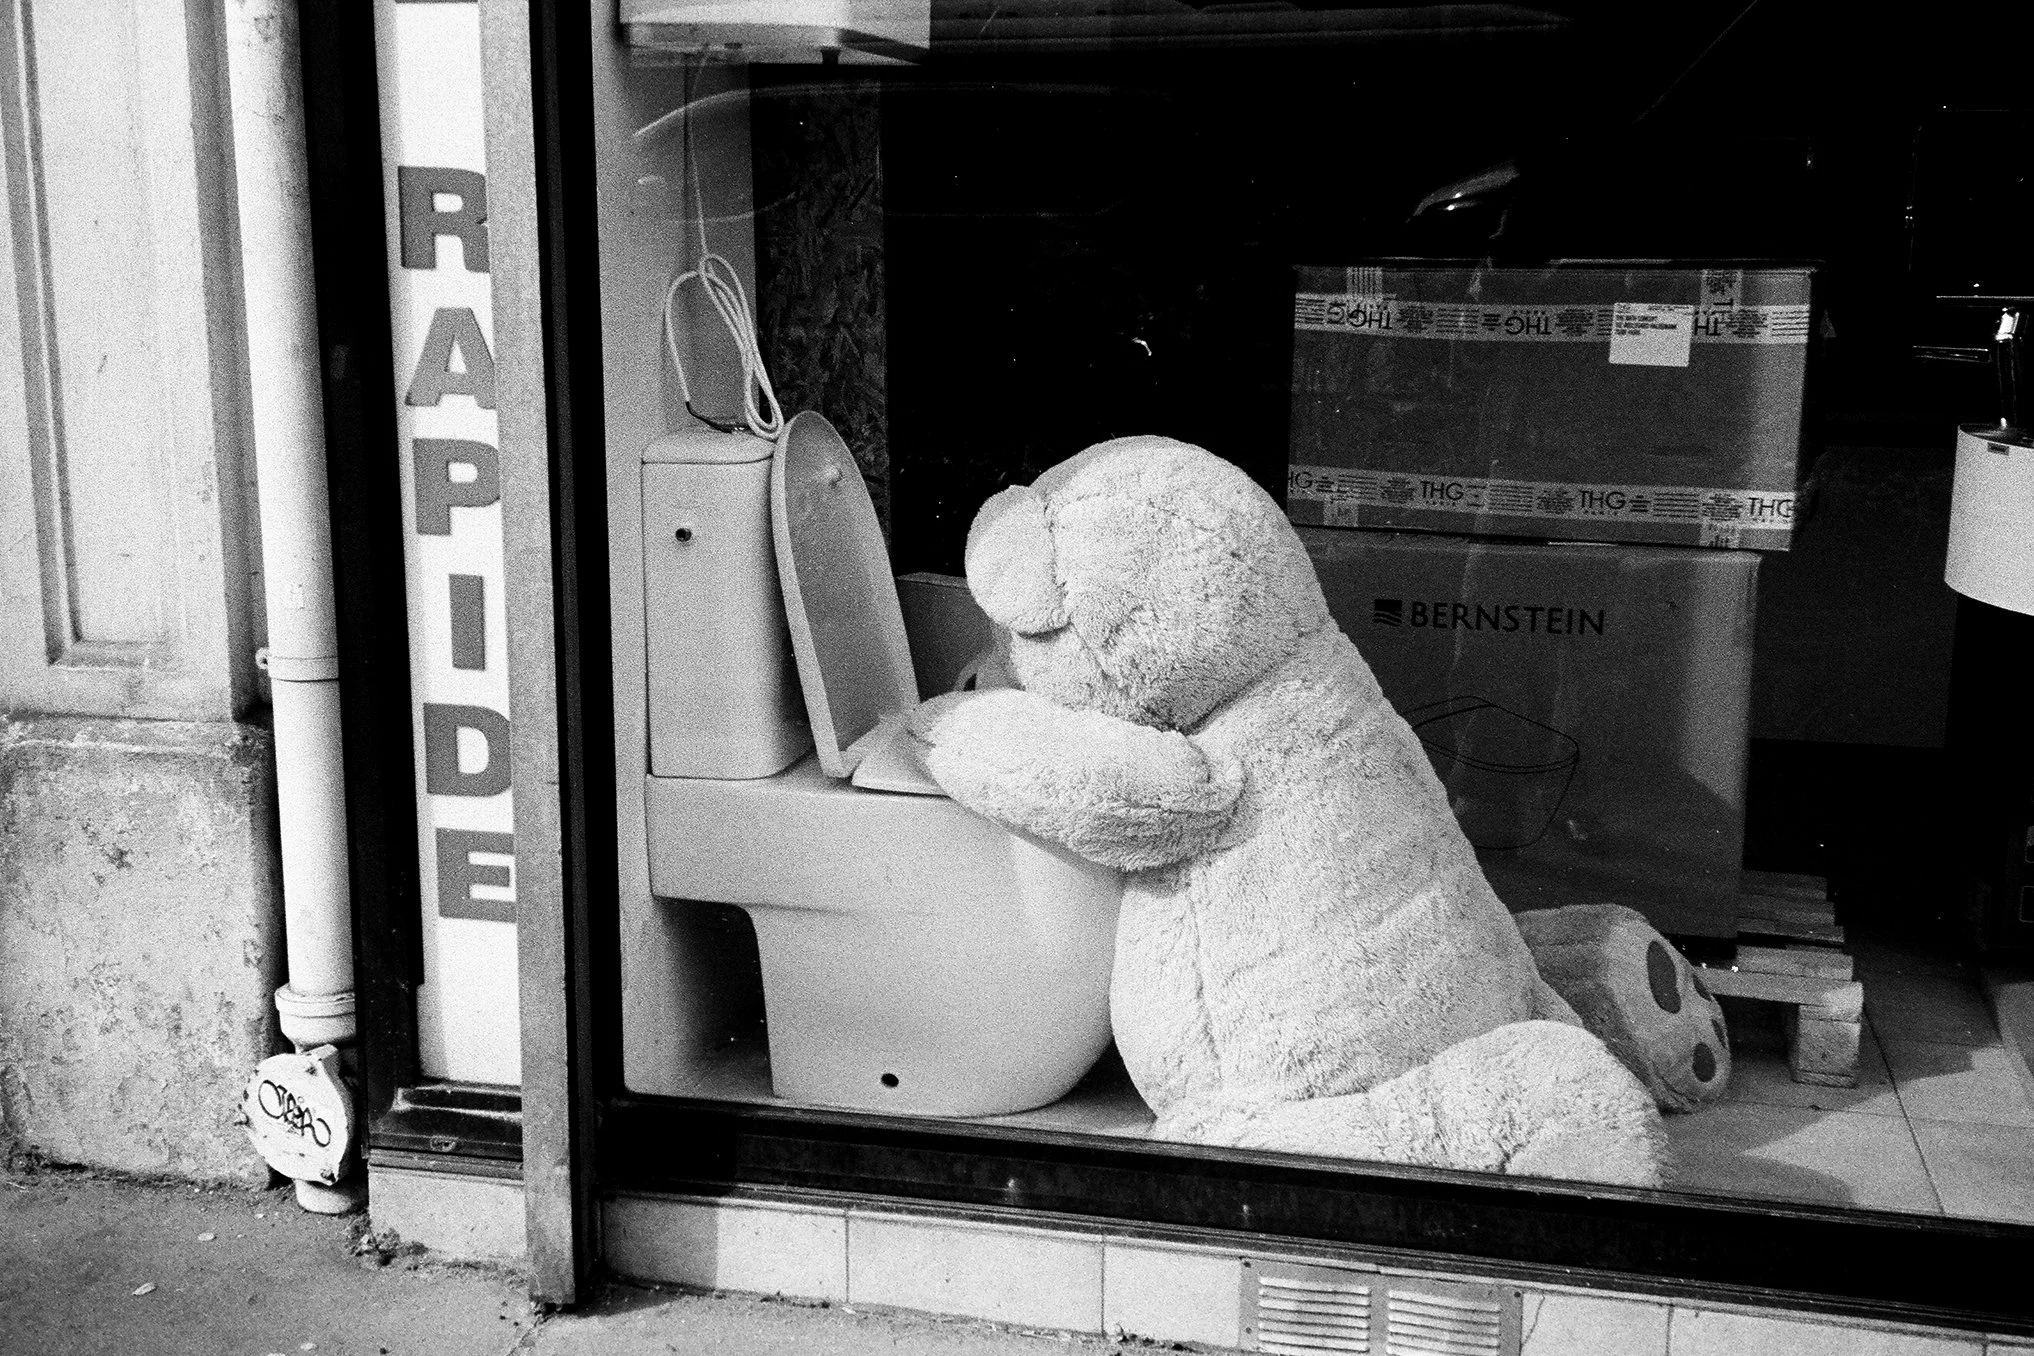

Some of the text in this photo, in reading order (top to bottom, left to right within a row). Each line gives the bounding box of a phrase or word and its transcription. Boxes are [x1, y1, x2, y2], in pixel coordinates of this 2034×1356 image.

[1504, 316, 1551, 335] THG
[1694, 316, 1721, 336] TH
[1420, 480, 1464, 501] THG
[1579, 490, 1626, 510] THG
[1748, 497, 1794, 518] THG
[397, 165, 519, 923] RAPIDE
[1410, 600, 1605, 636] BERNSTEIN
